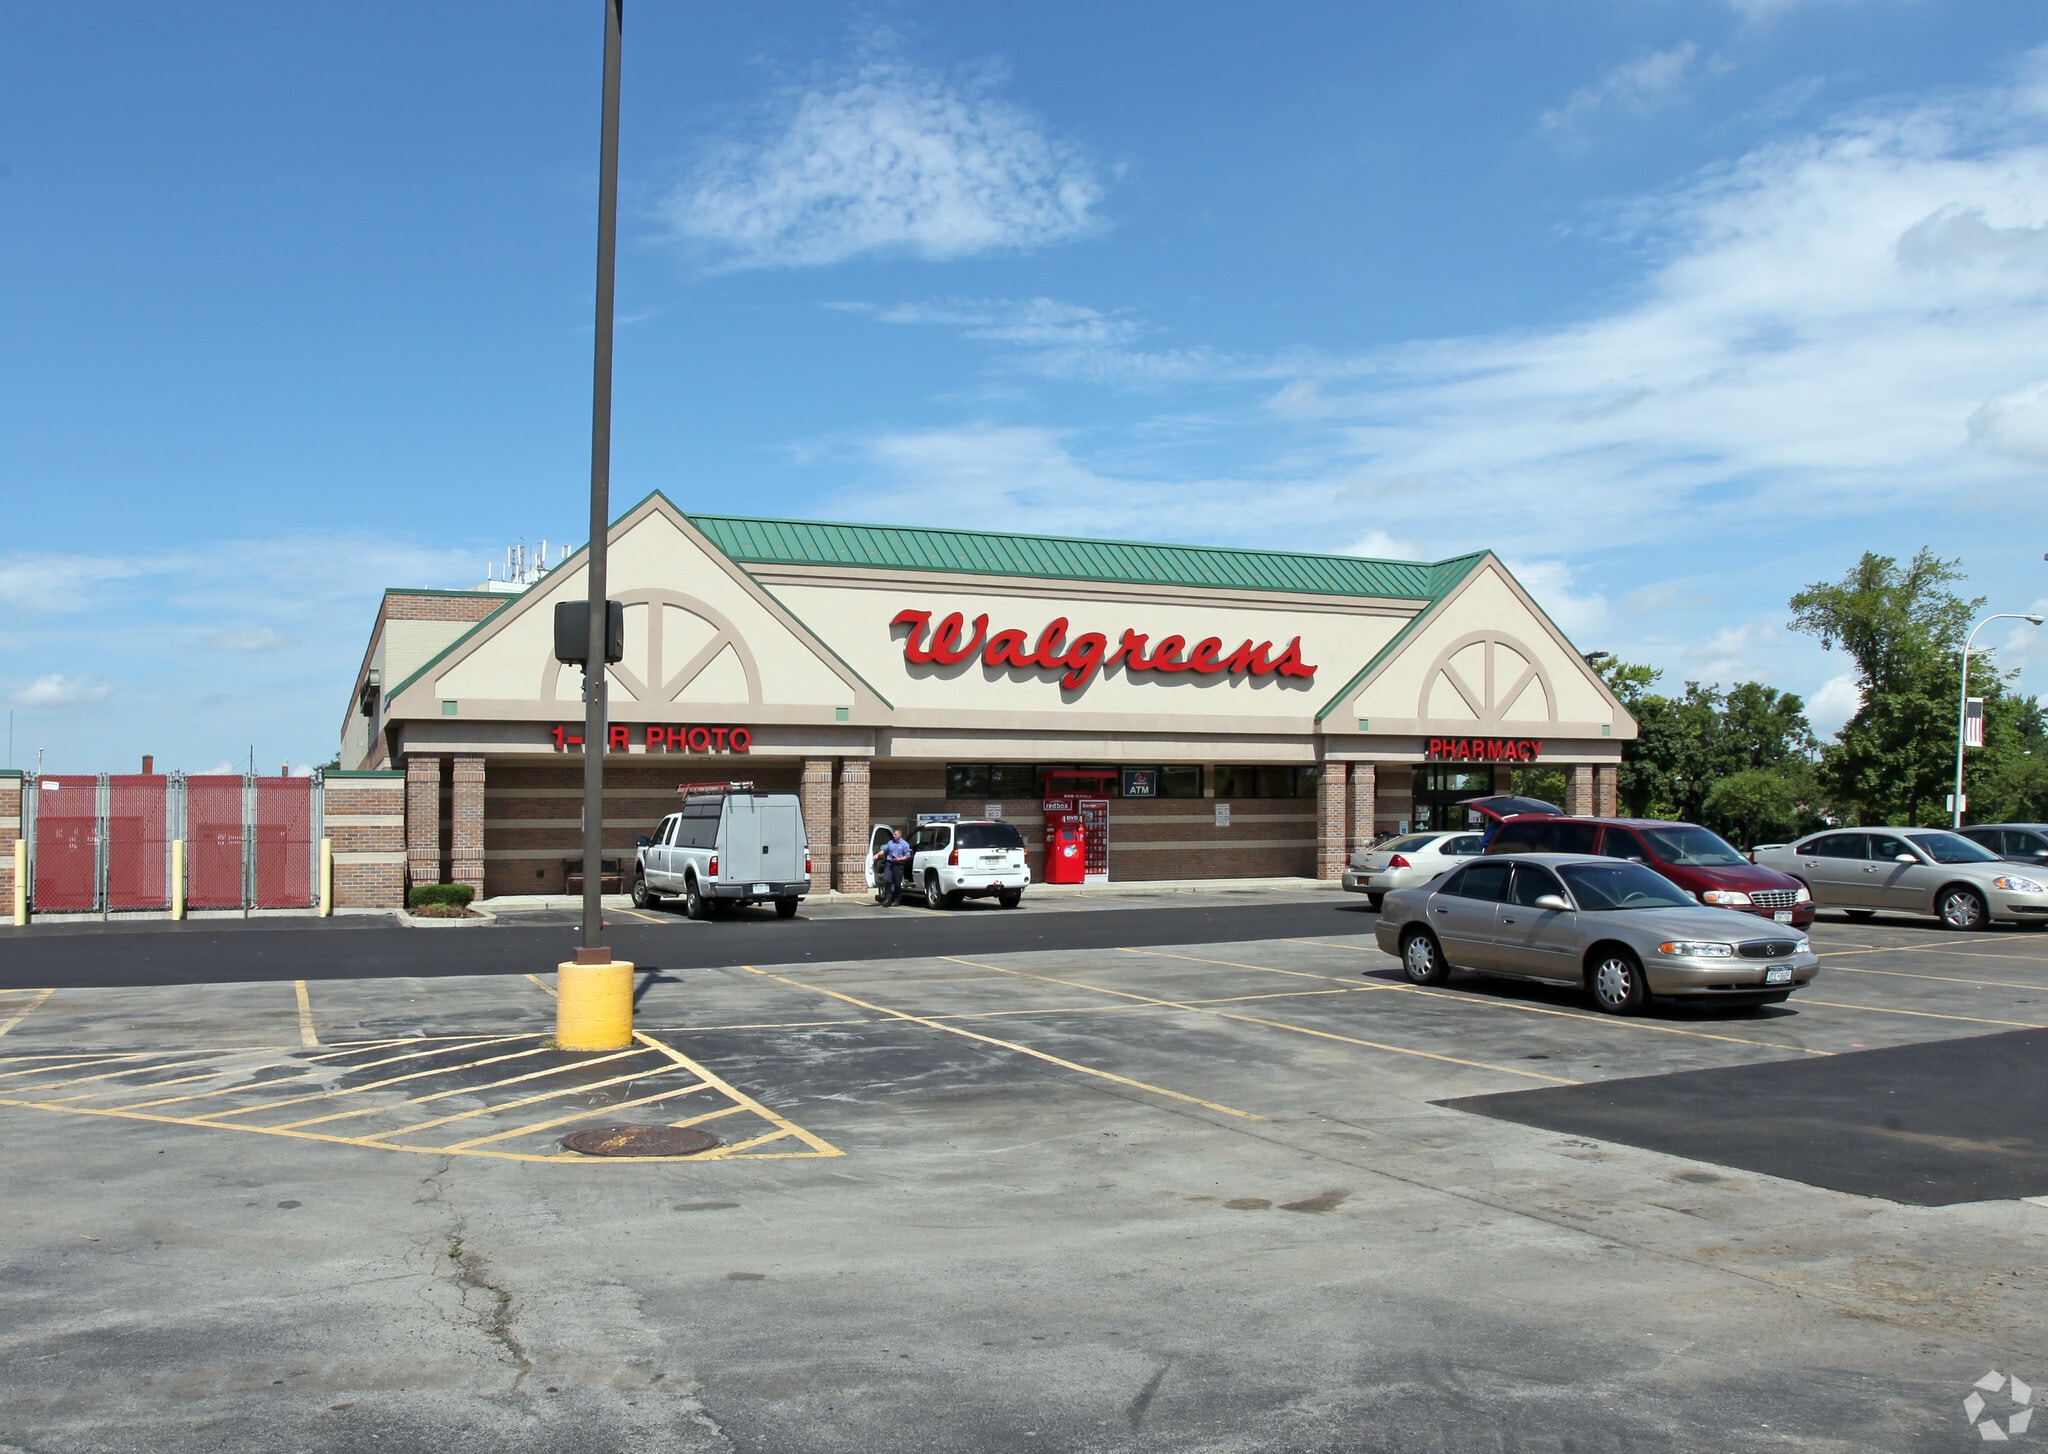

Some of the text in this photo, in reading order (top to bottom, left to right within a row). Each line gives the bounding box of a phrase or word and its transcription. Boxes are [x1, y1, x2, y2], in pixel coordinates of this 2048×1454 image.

[892, 609, 1318, 690] Walgreens
[552, 725, 752, 751] 1-R PHOTO
[1429, 738, 1543, 760] PHARMACY
[1129, 786, 1149, 795] ATM
